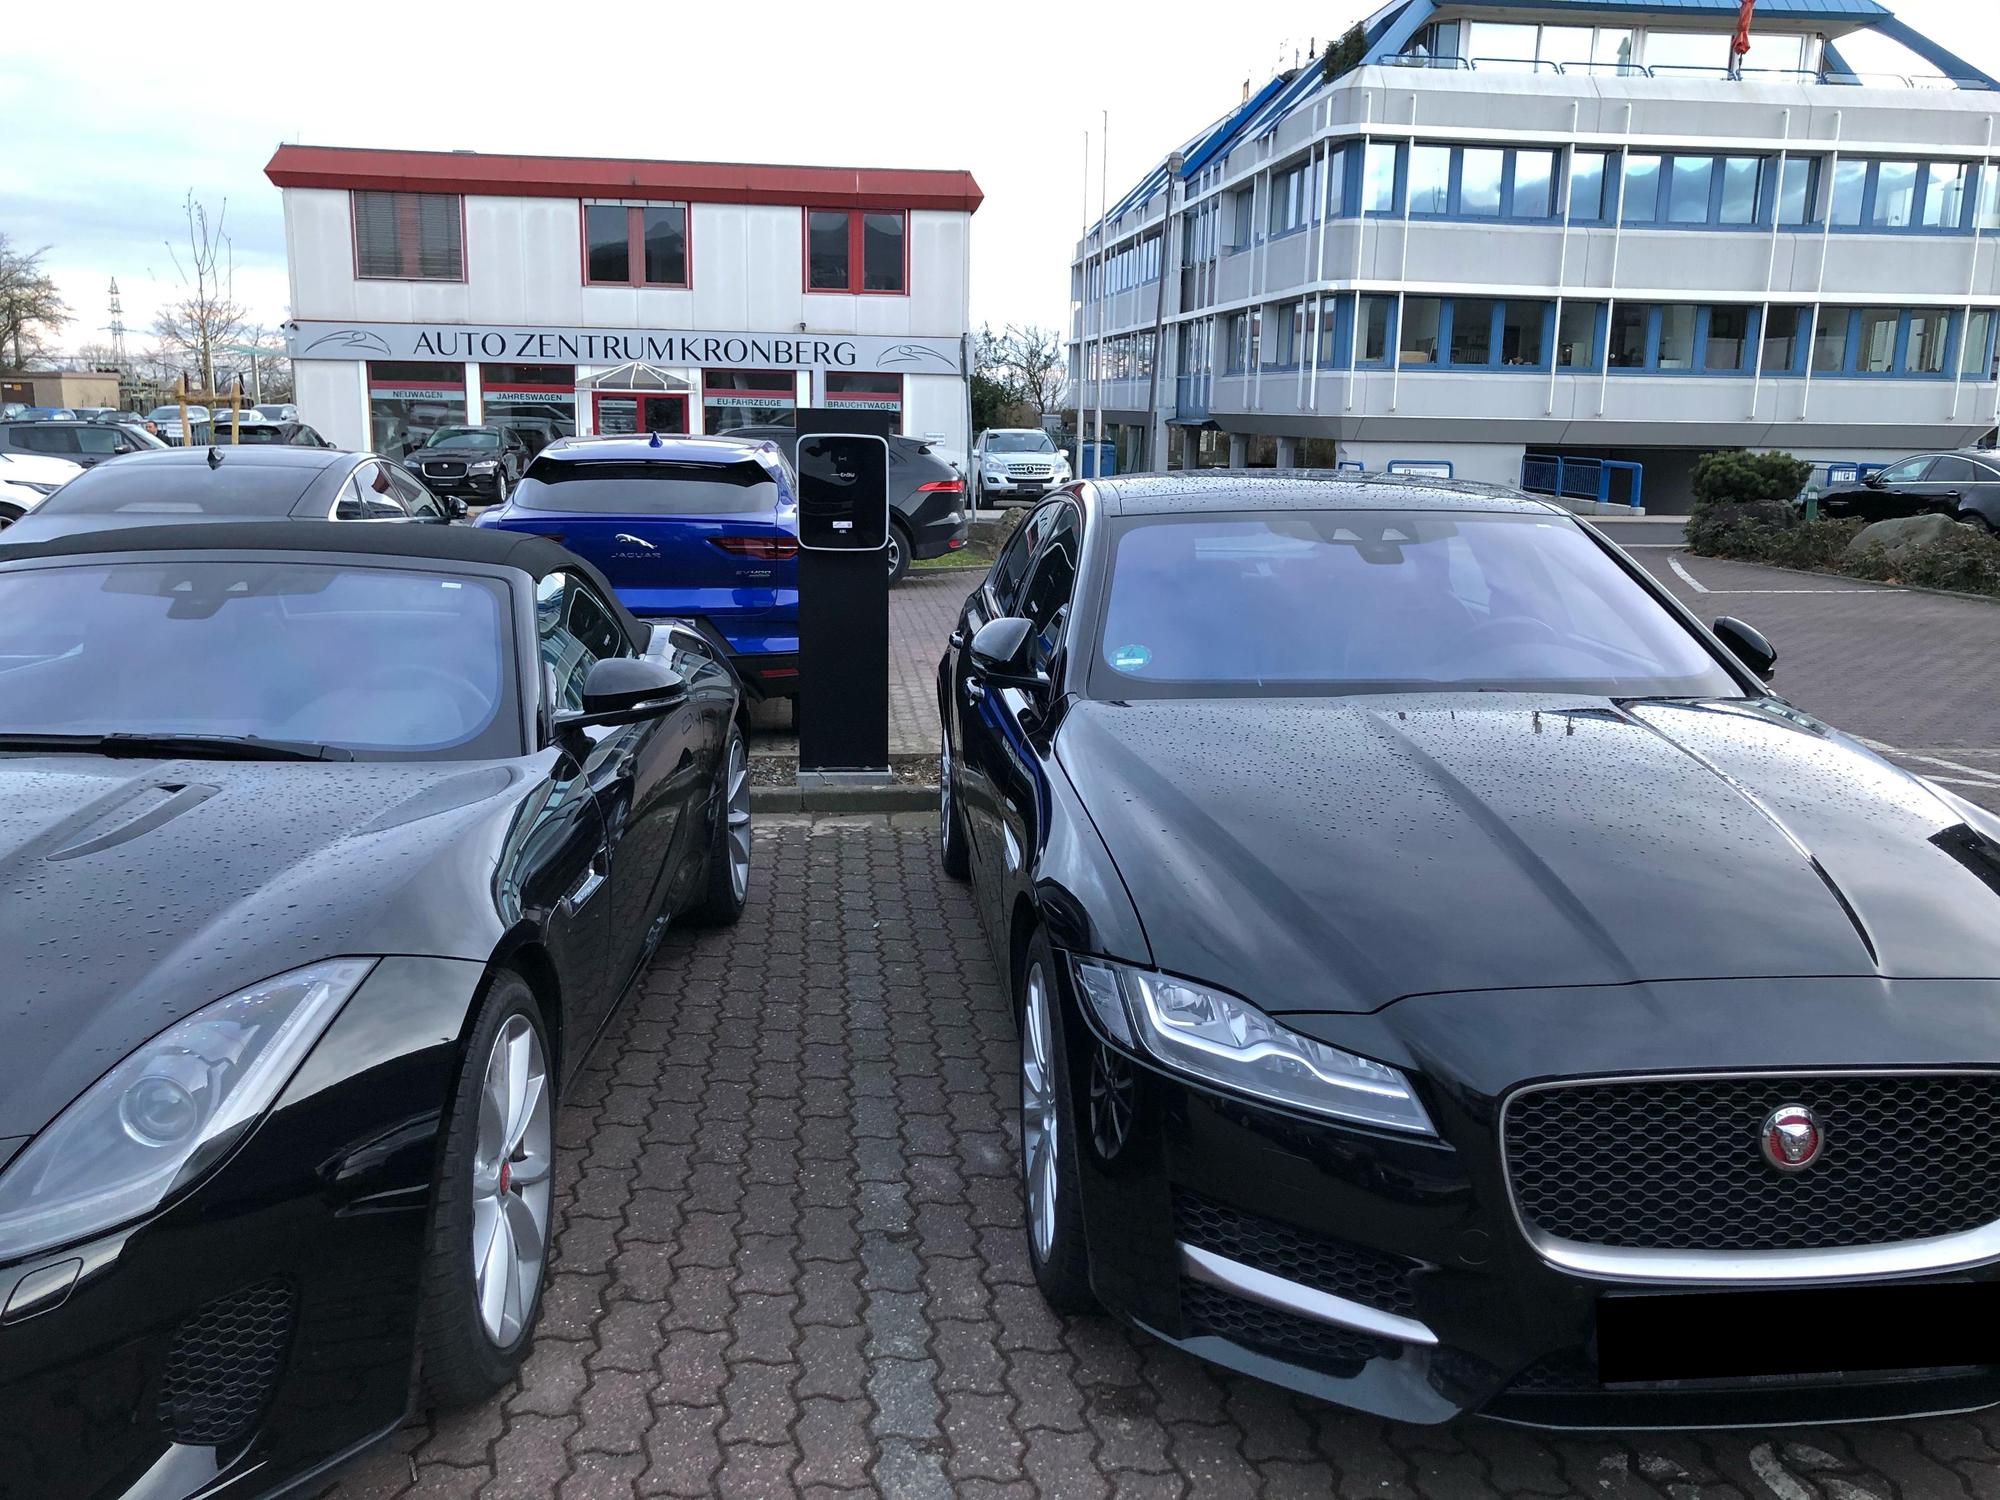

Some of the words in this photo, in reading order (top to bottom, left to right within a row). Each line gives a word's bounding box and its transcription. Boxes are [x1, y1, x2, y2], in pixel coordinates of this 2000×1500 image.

[413, 331, 507, 357] AUTO
[514, 333, 673, 361] ZENTRUM
[681, 337, 857, 366] KRONBERG
[392, 390, 443, 399] NEUWAGEN
[496, 392, 562, 401] JAHRESWAGEN
[716, 398, 782, 407] EU-FAHRZEUGE
